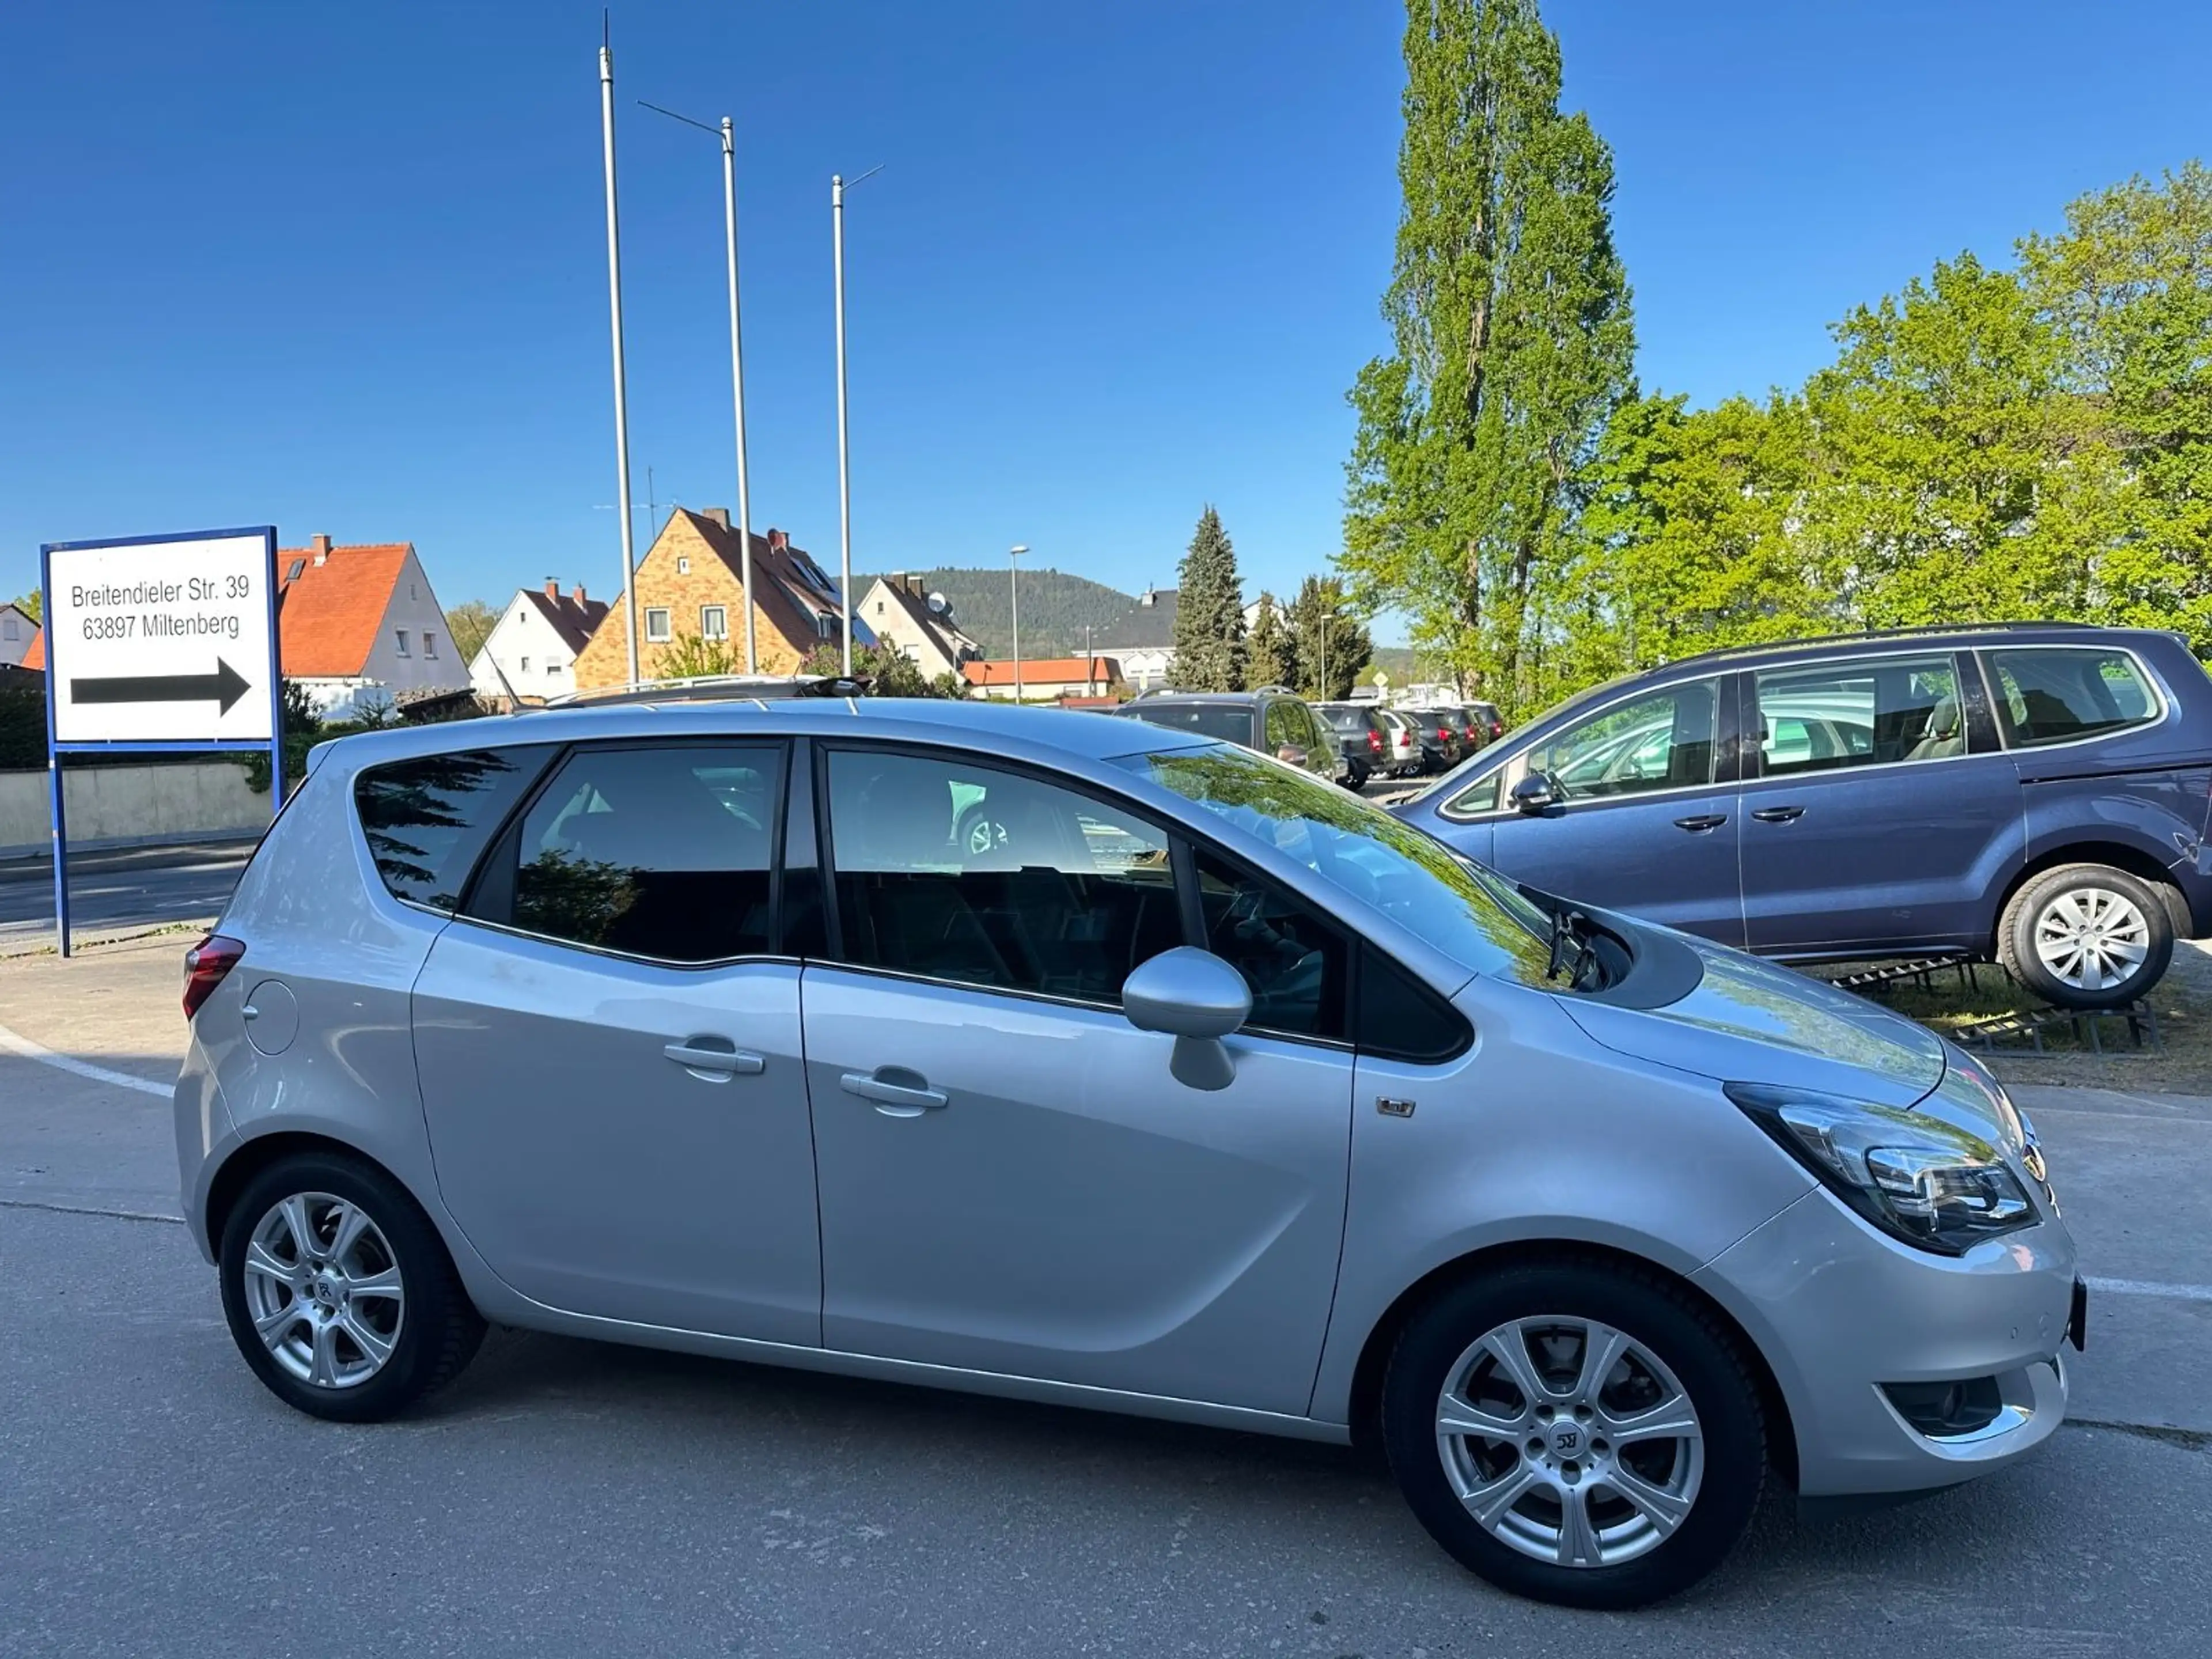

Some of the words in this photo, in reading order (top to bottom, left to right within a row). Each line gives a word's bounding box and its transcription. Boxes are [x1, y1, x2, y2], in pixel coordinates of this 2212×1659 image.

[72, 581, 182, 607] Breitendieler
[188, 577, 218, 601] Str.
[225, 575, 249, 599] 39
[82, 616, 136, 640] 63897
[142, 612, 240, 639] Miltenberg
